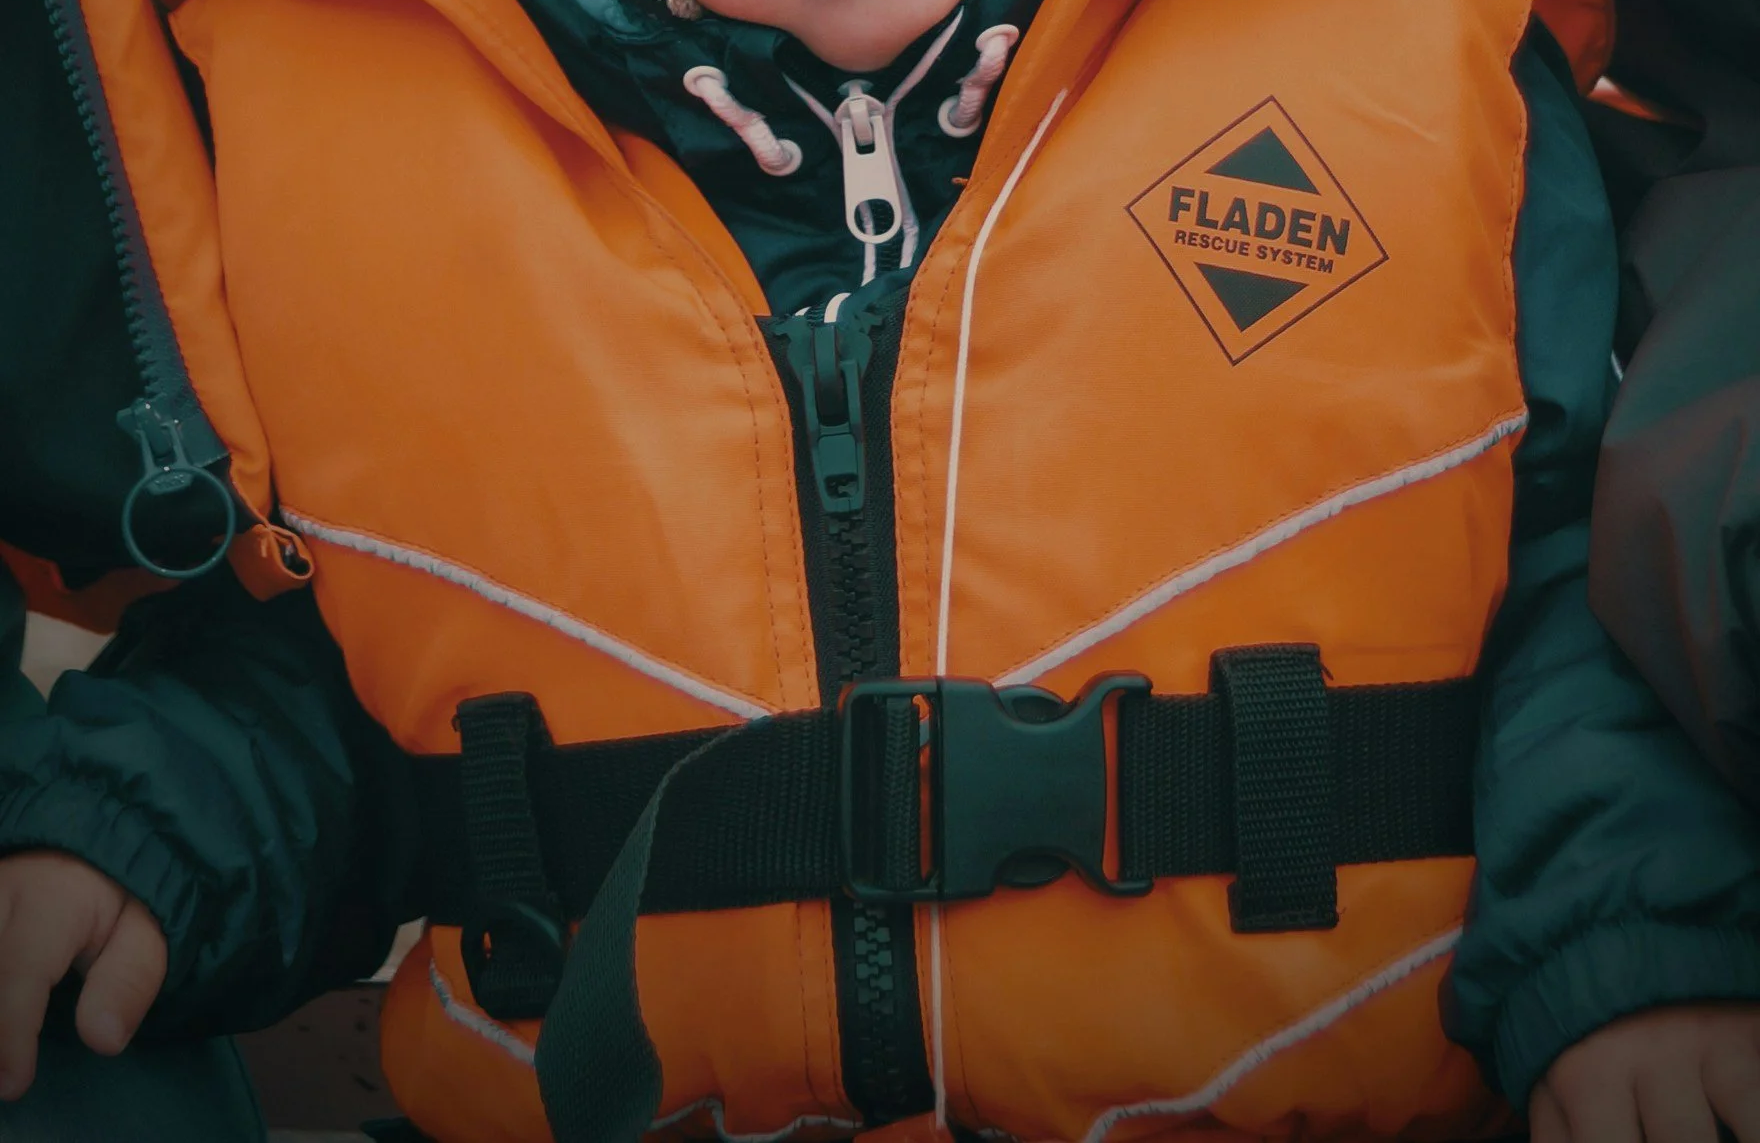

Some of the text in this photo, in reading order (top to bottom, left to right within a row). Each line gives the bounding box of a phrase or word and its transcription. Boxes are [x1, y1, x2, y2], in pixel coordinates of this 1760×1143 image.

[1169, 187, 1350, 255] FLADEN
[1175, 231, 1334, 273] RESCUE SYSTEM
